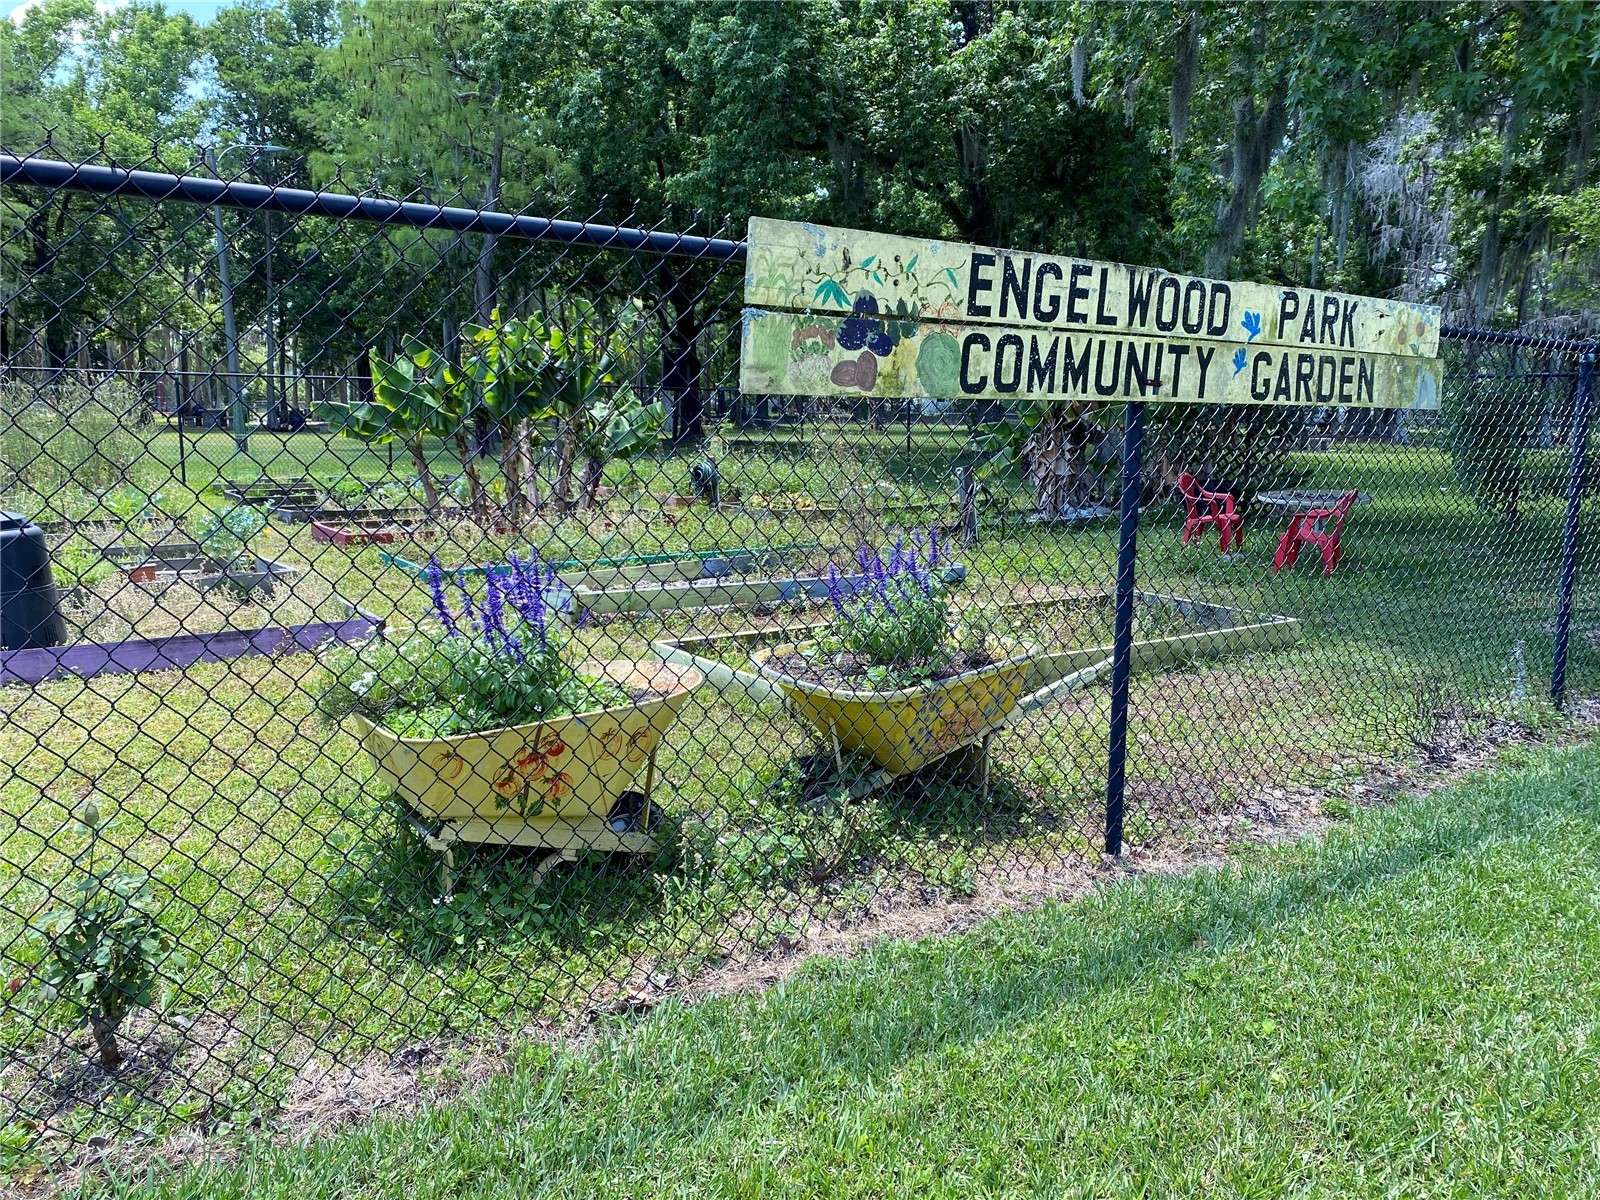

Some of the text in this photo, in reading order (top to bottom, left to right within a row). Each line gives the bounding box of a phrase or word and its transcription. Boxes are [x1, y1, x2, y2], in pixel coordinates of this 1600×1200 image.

[967, 252, 1359, 348] ENGELWOOD PARK
[959, 332, 1375, 403] COMMUNITY GARDEN
